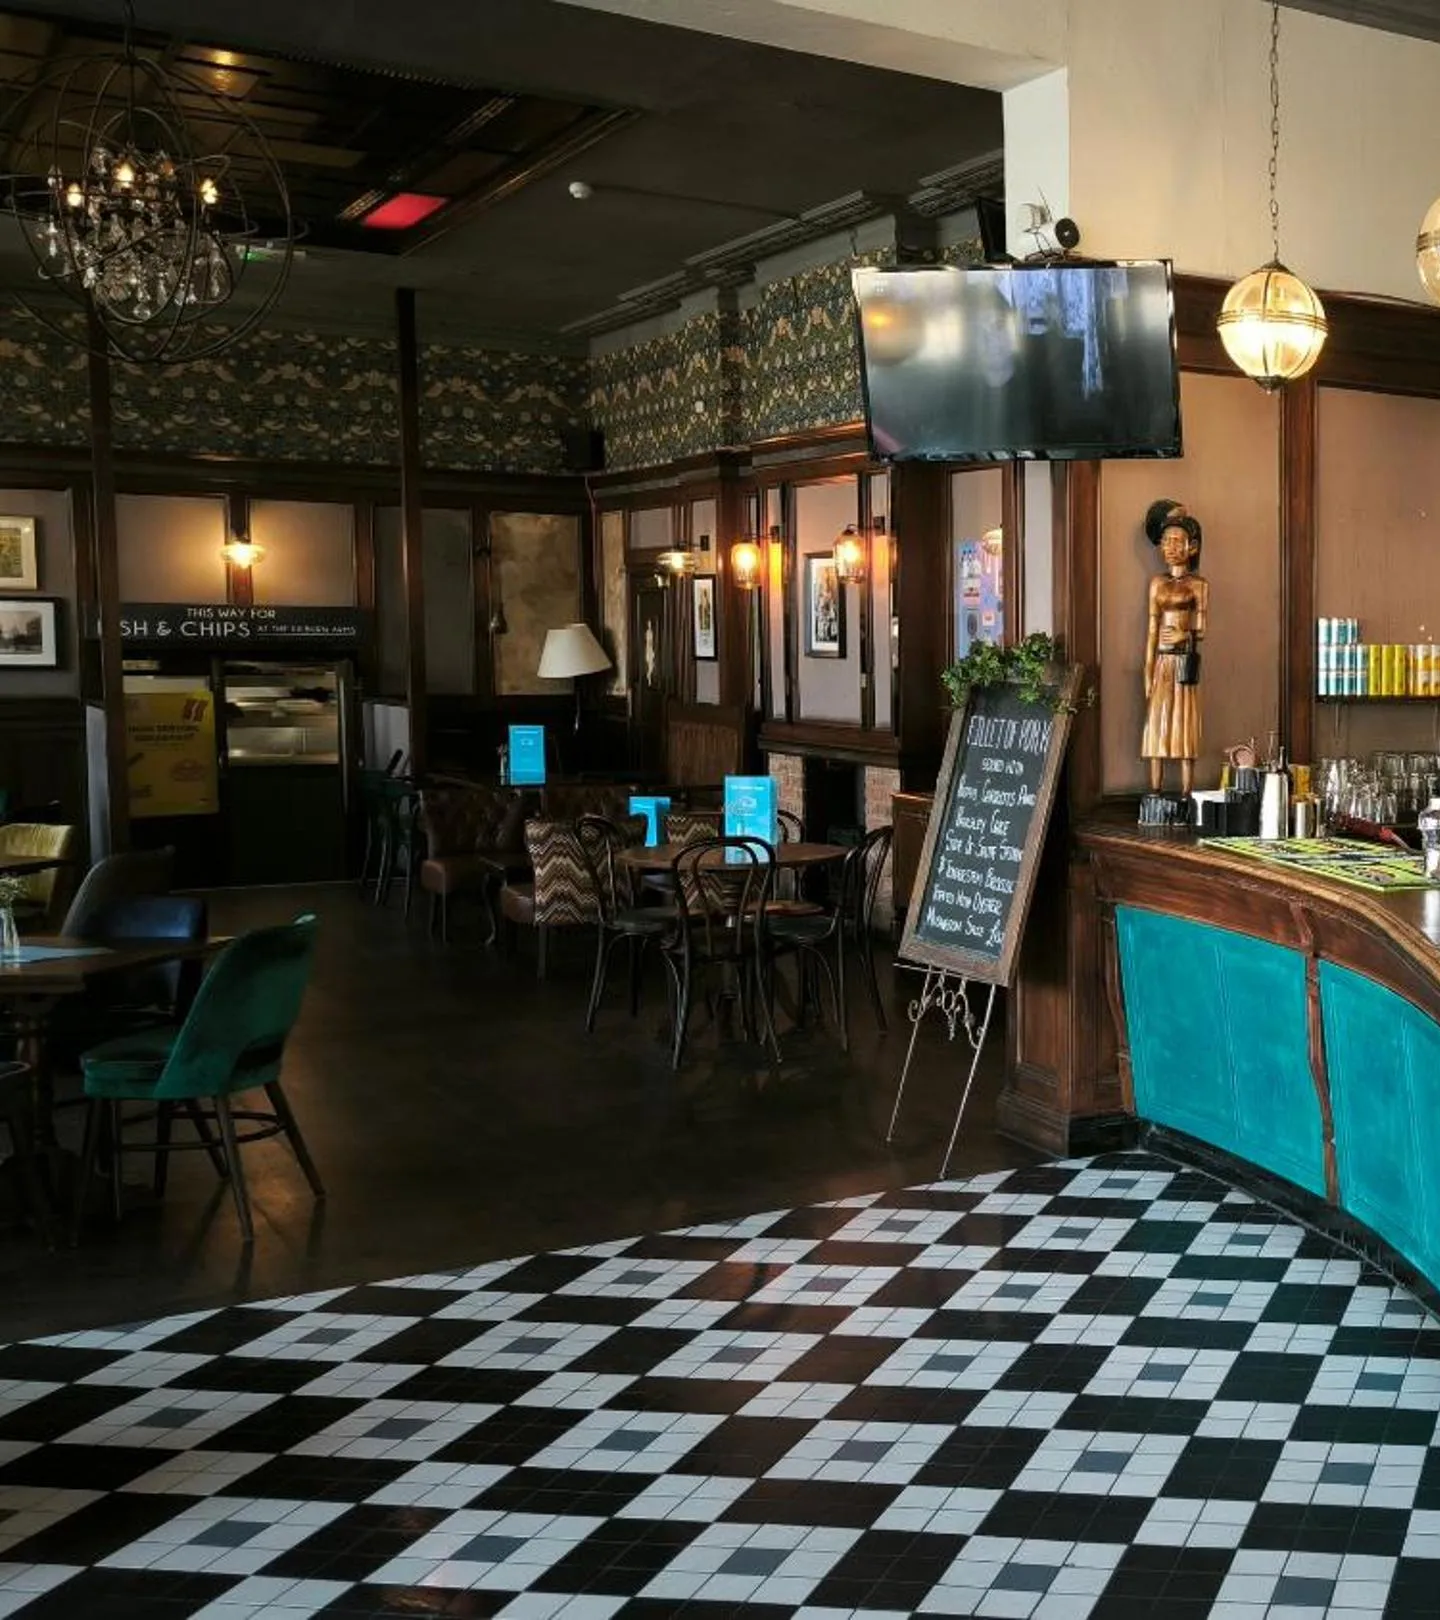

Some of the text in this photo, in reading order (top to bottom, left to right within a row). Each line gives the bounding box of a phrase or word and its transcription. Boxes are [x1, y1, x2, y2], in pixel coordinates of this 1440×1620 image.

[187, 608, 276, 619] THIS WAY FOR
[156, 621, 172, 637] &
[180, 621, 250, 637] CHIPS
